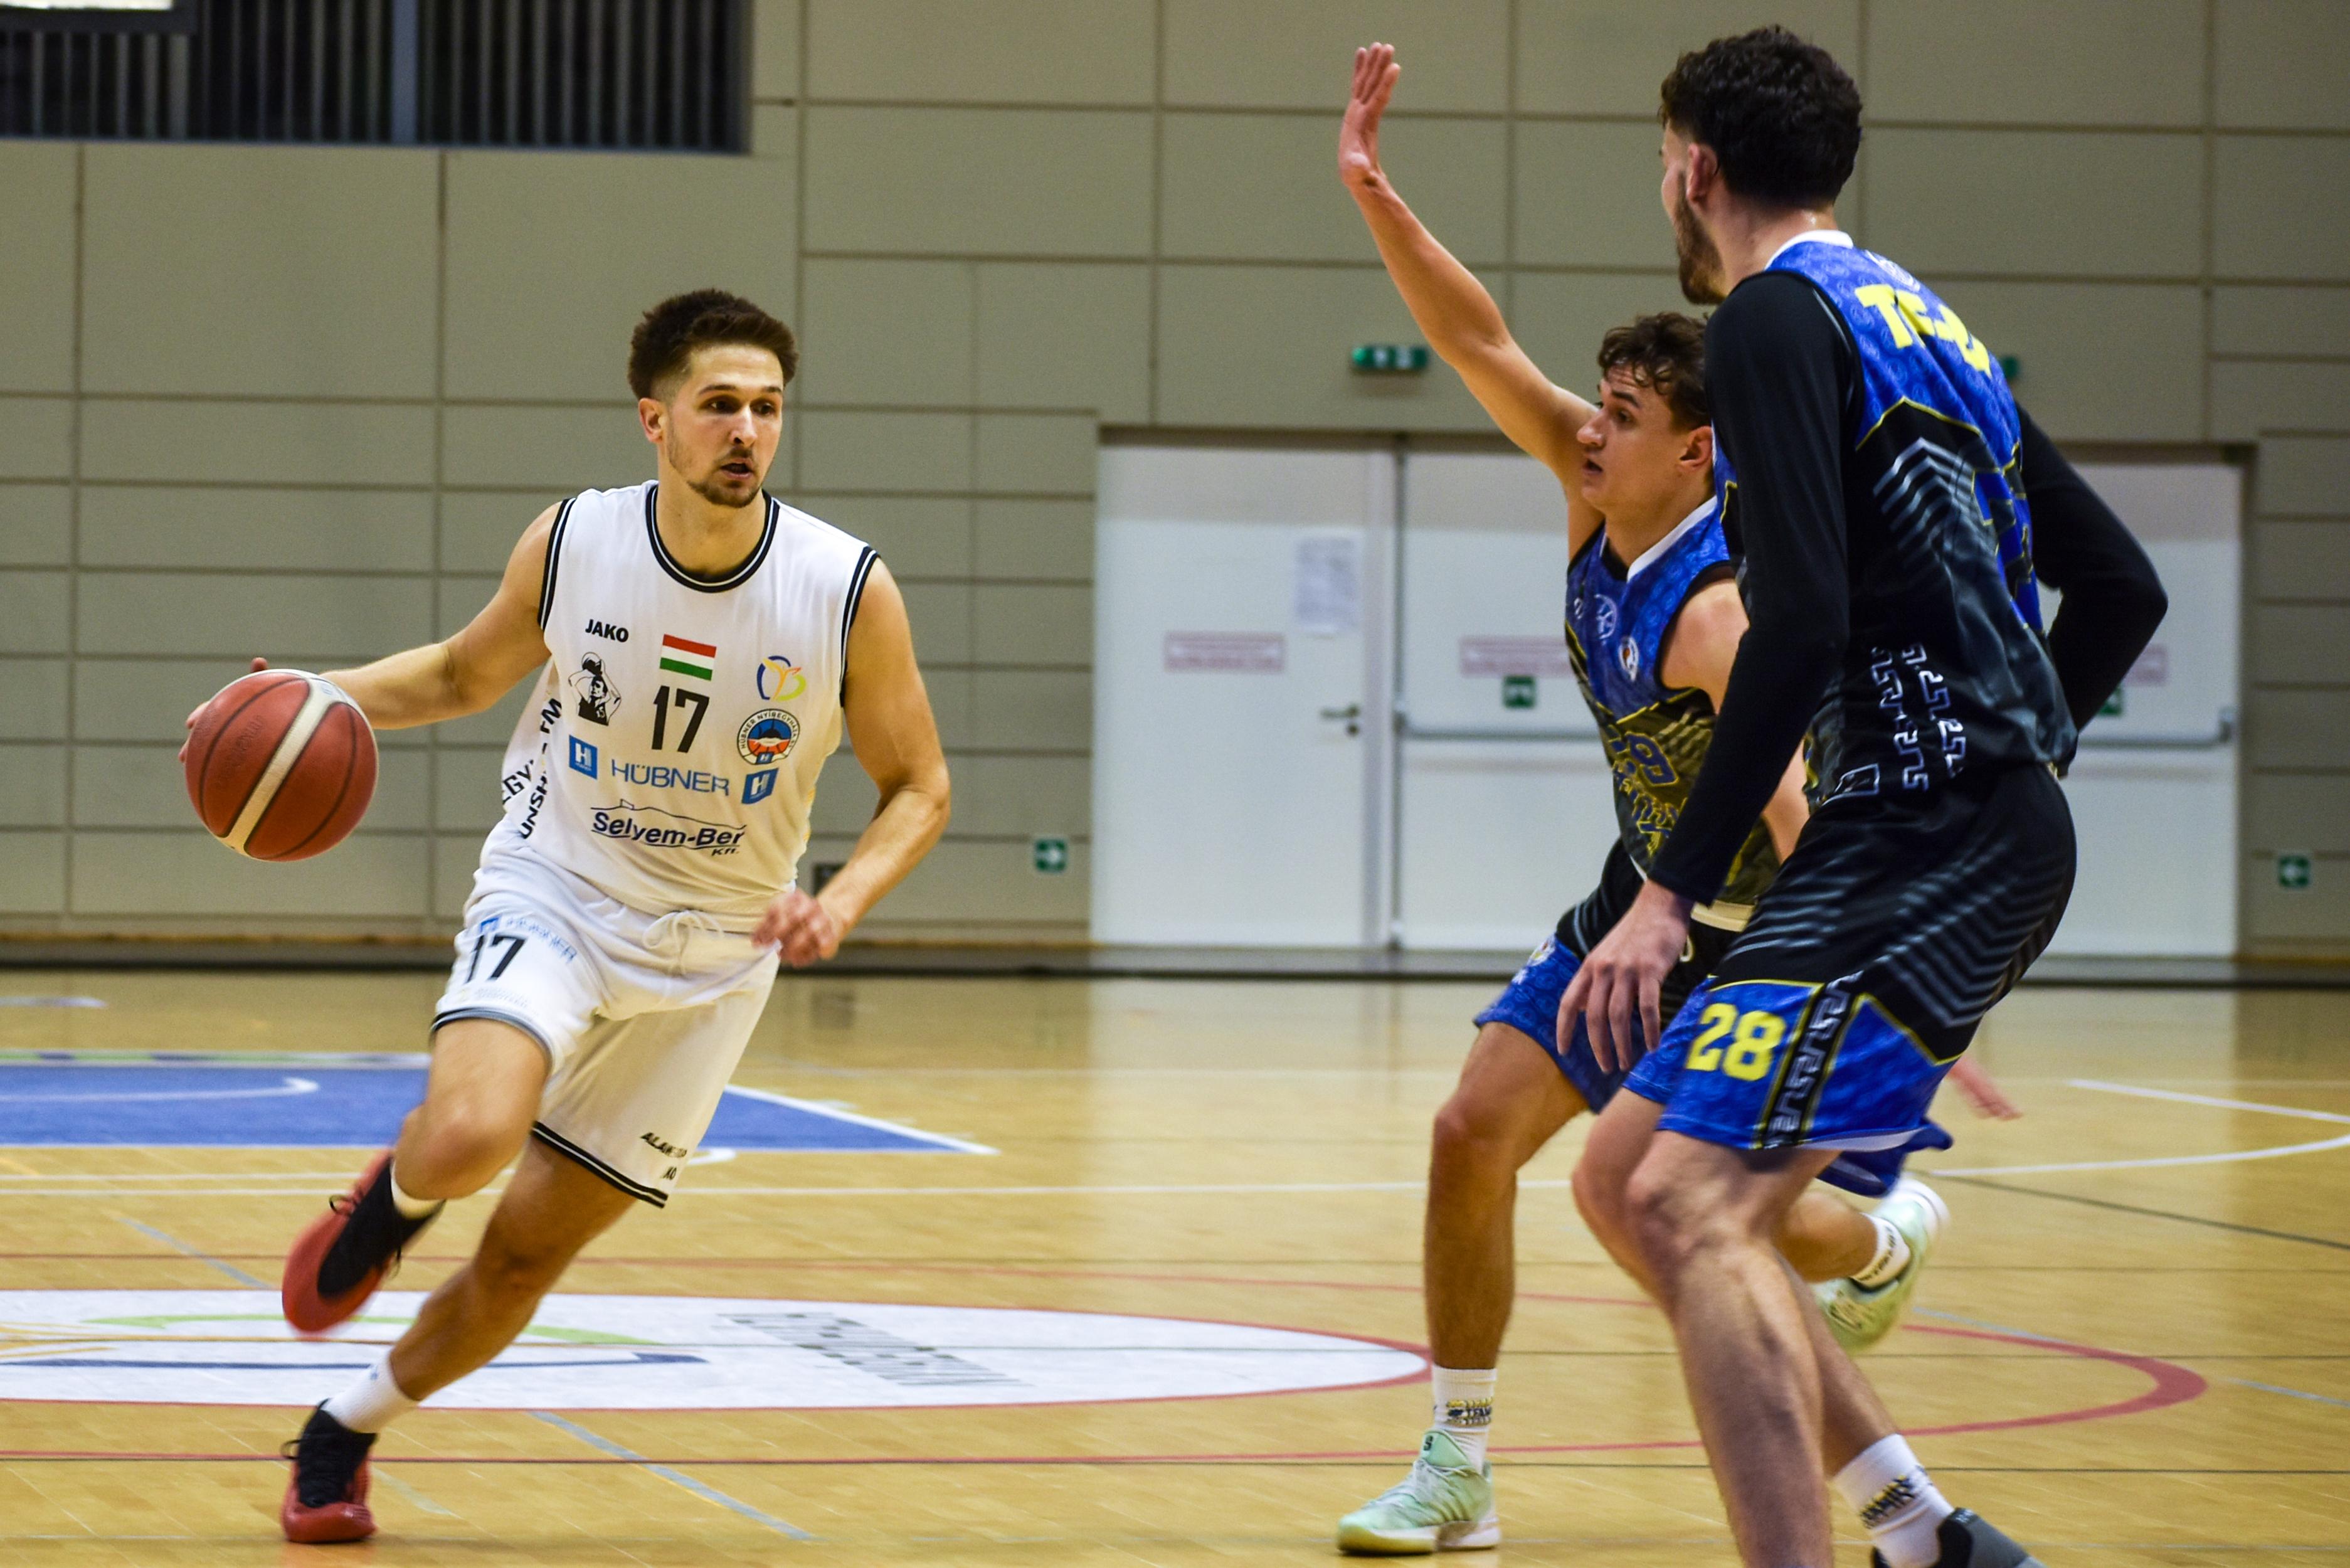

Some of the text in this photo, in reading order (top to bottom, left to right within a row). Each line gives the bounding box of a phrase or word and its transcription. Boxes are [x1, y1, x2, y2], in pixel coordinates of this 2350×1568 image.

[585, 618, 629, 643] JAKO
[651, 685, 710, 753] 17
[611, 758, 729, 797] HÜBNER
[593, 812, 746, 846] Selyem-Ber
[465, 933, 527, 984] 17
[1685, 1003, 1787, 1082] 28
